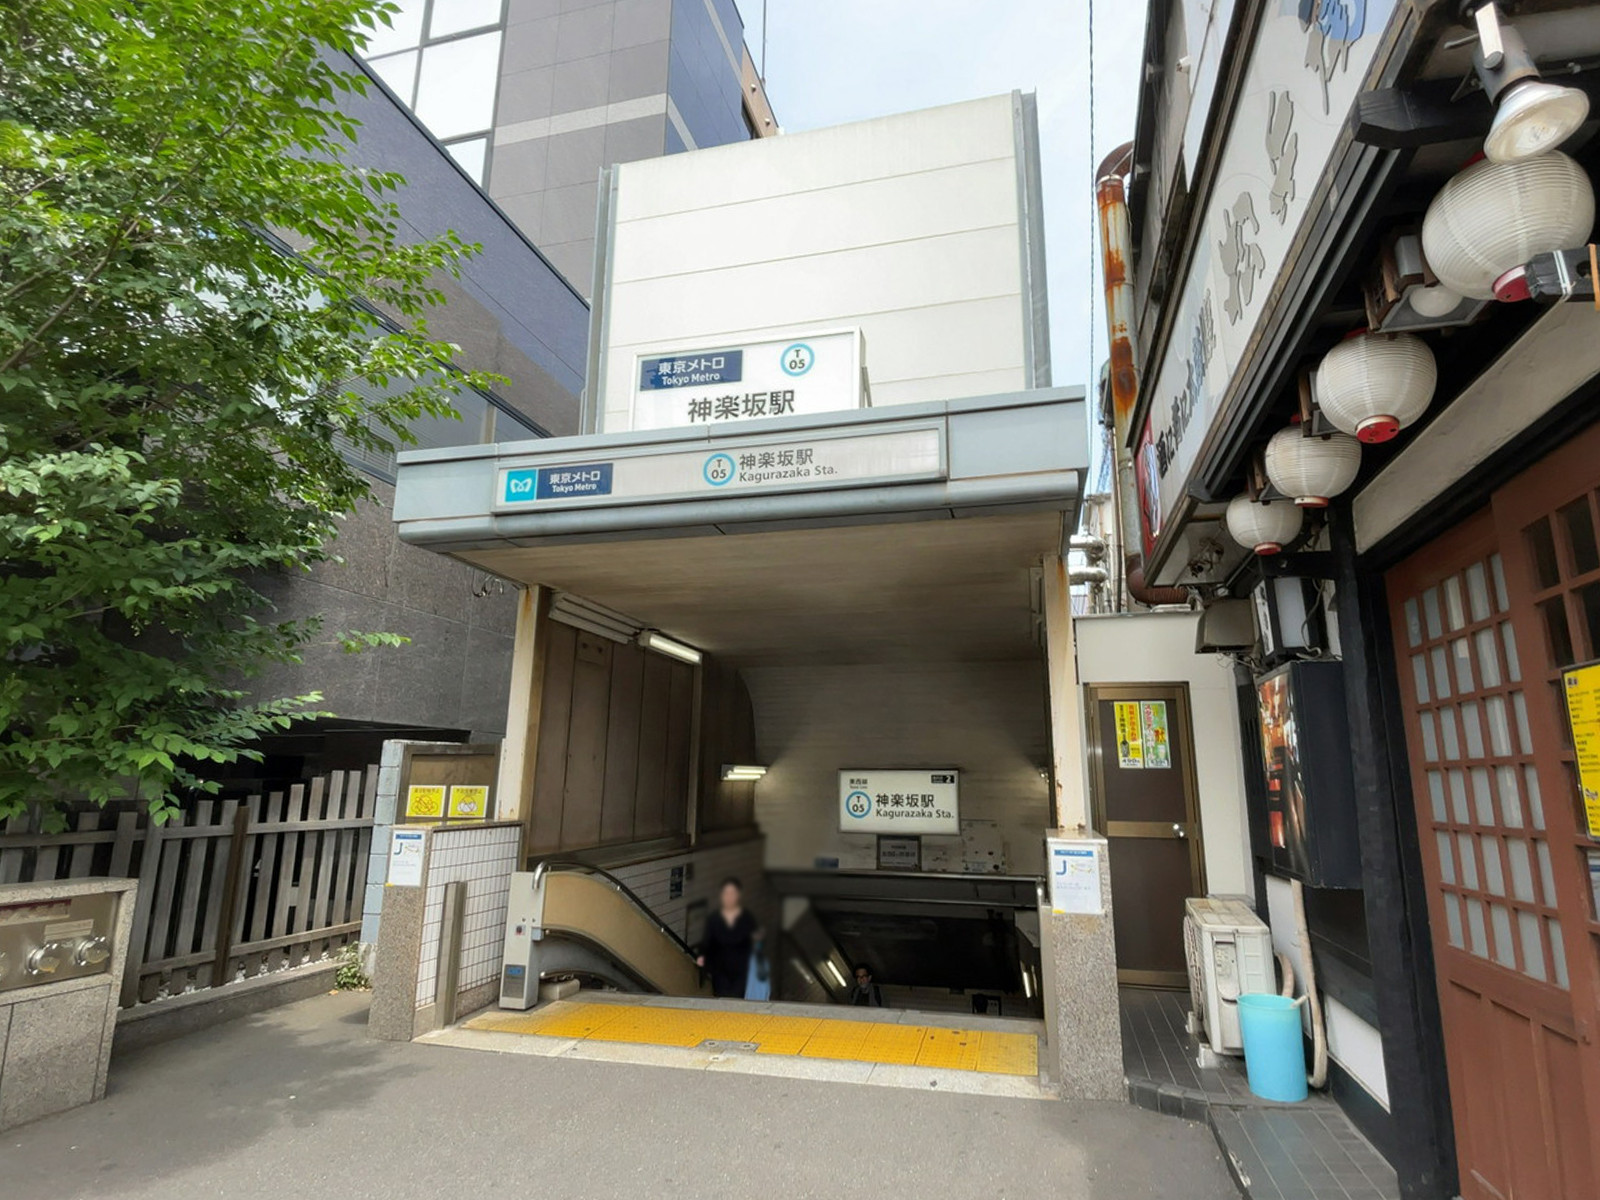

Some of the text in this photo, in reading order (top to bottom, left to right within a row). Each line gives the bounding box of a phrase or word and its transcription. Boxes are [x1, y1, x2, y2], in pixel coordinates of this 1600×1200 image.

[794, 349, 801, 358] T
[658, 356, 725, 376] 東京メトロ
[789, 360, 806, 370] 05
[662, 372, 721, 387] Tokyo Metro
[687, 389, 796, 423] 神楽坂駅
[716, 458, 723, 468] T
[739, 448, 814, 471] 神楽坂駅
[549, 470, 601, 484] 東京メトロ
[711, 469, 727, 479] 05
[739, 465, 839, 483] Kagurazaka Sta.
[552, 482, 597, 493] Tokyo Metro
[875, 793, 935, 808] 神楽坂駅
[851, 803, 865, 813] 05
[875, 808, 955, 820] Kagurazaka Sta.
